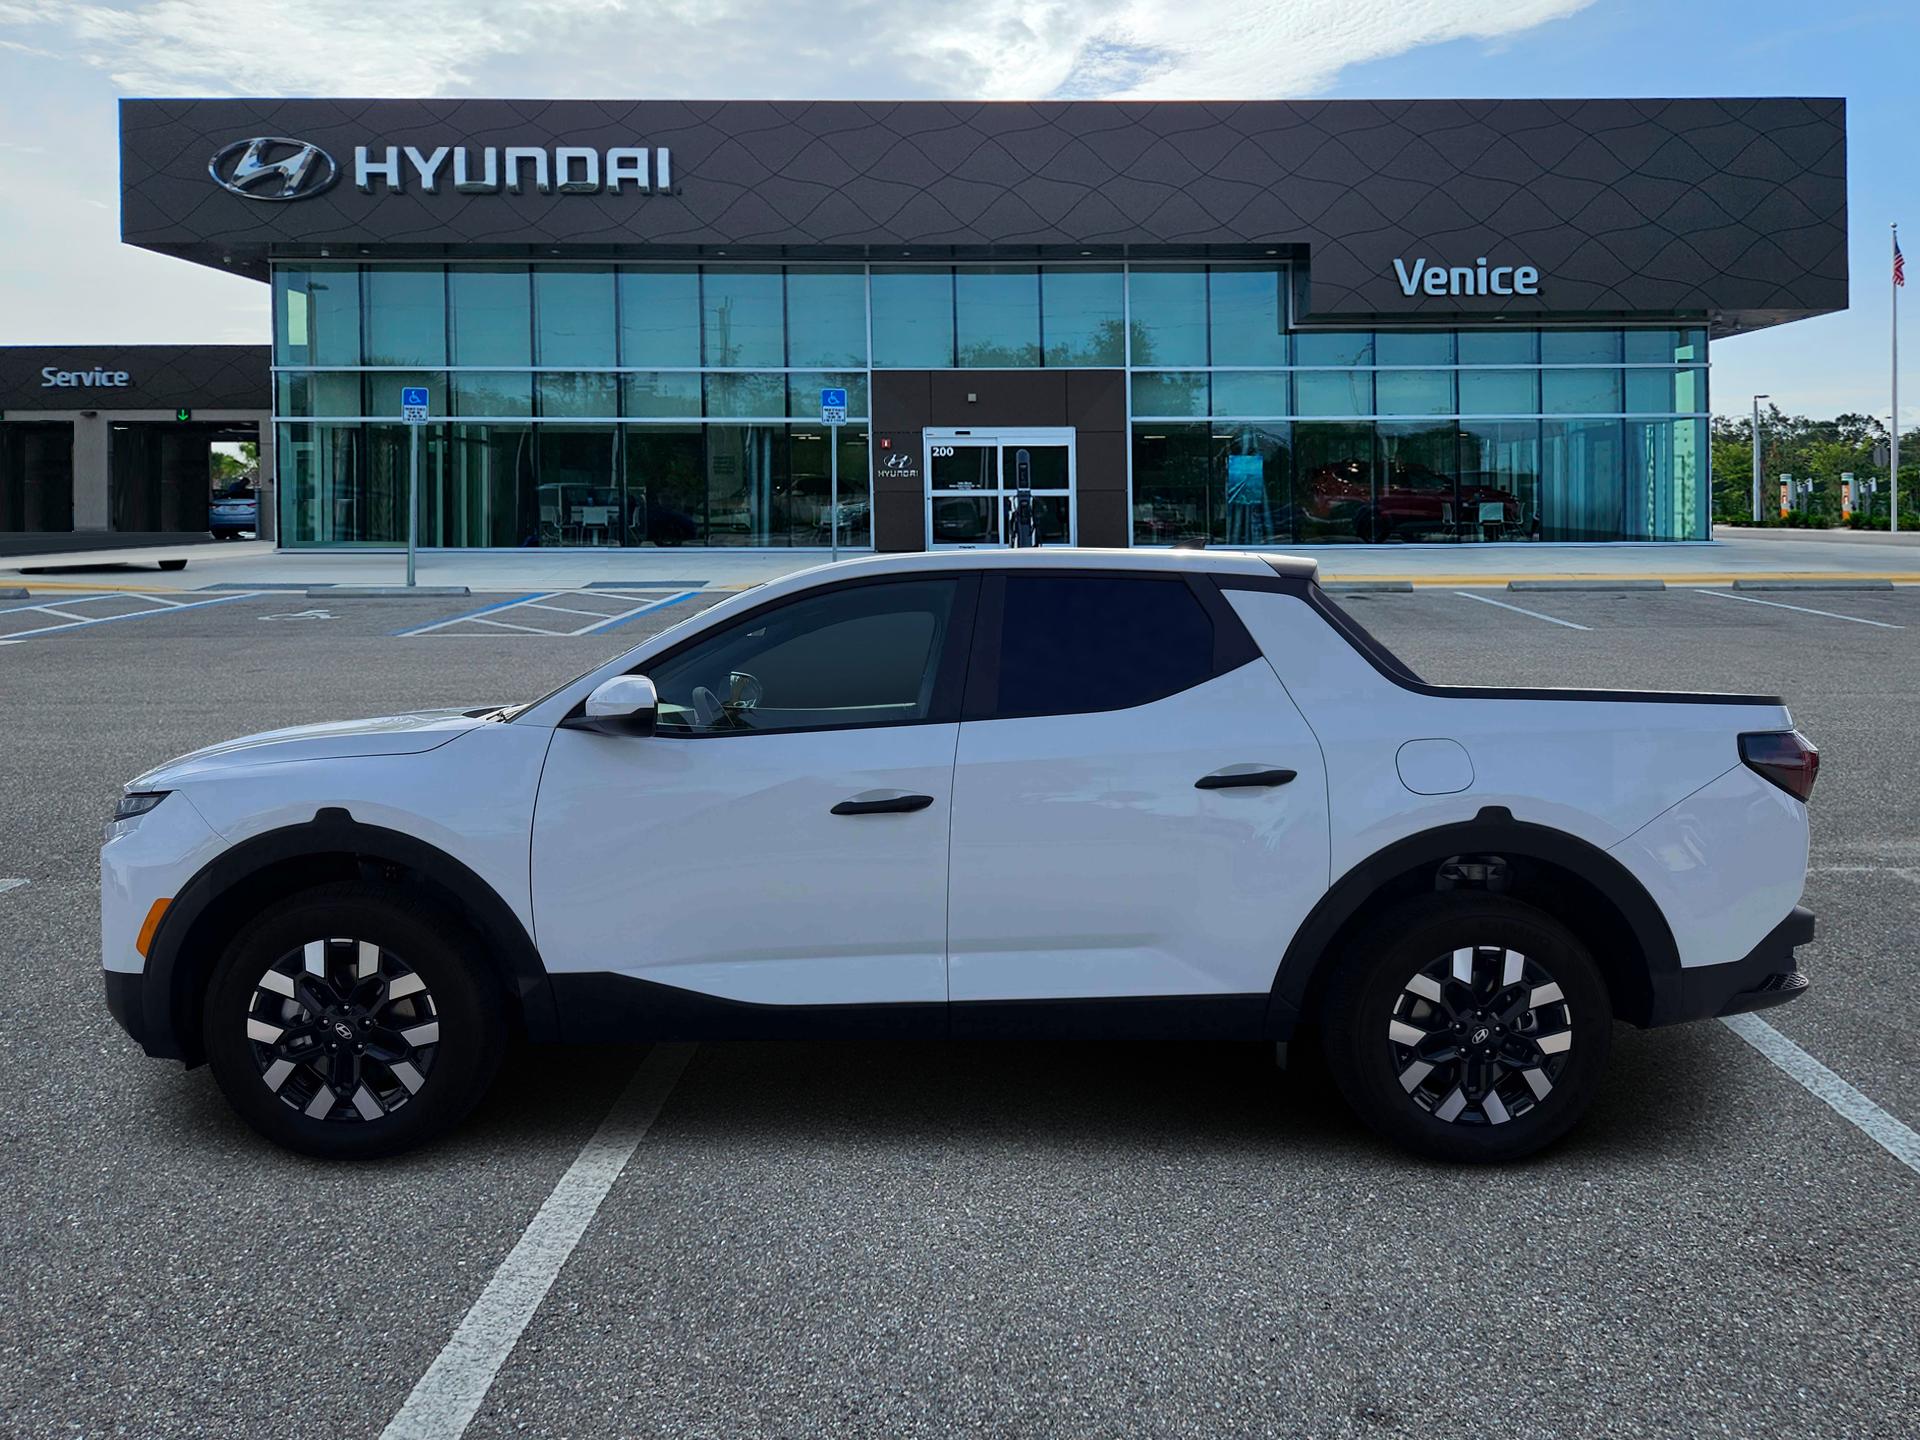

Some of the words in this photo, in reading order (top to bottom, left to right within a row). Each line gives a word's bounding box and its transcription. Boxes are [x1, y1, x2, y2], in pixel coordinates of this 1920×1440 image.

[354, 146, 671, 194] HYUNDAI
[1392, 256, 1539, 296] Venice
[41, 366, 129, 387] Service
[932, 446, 954, 457] 200
[877, 469, 919, 478] HYUNDAI
